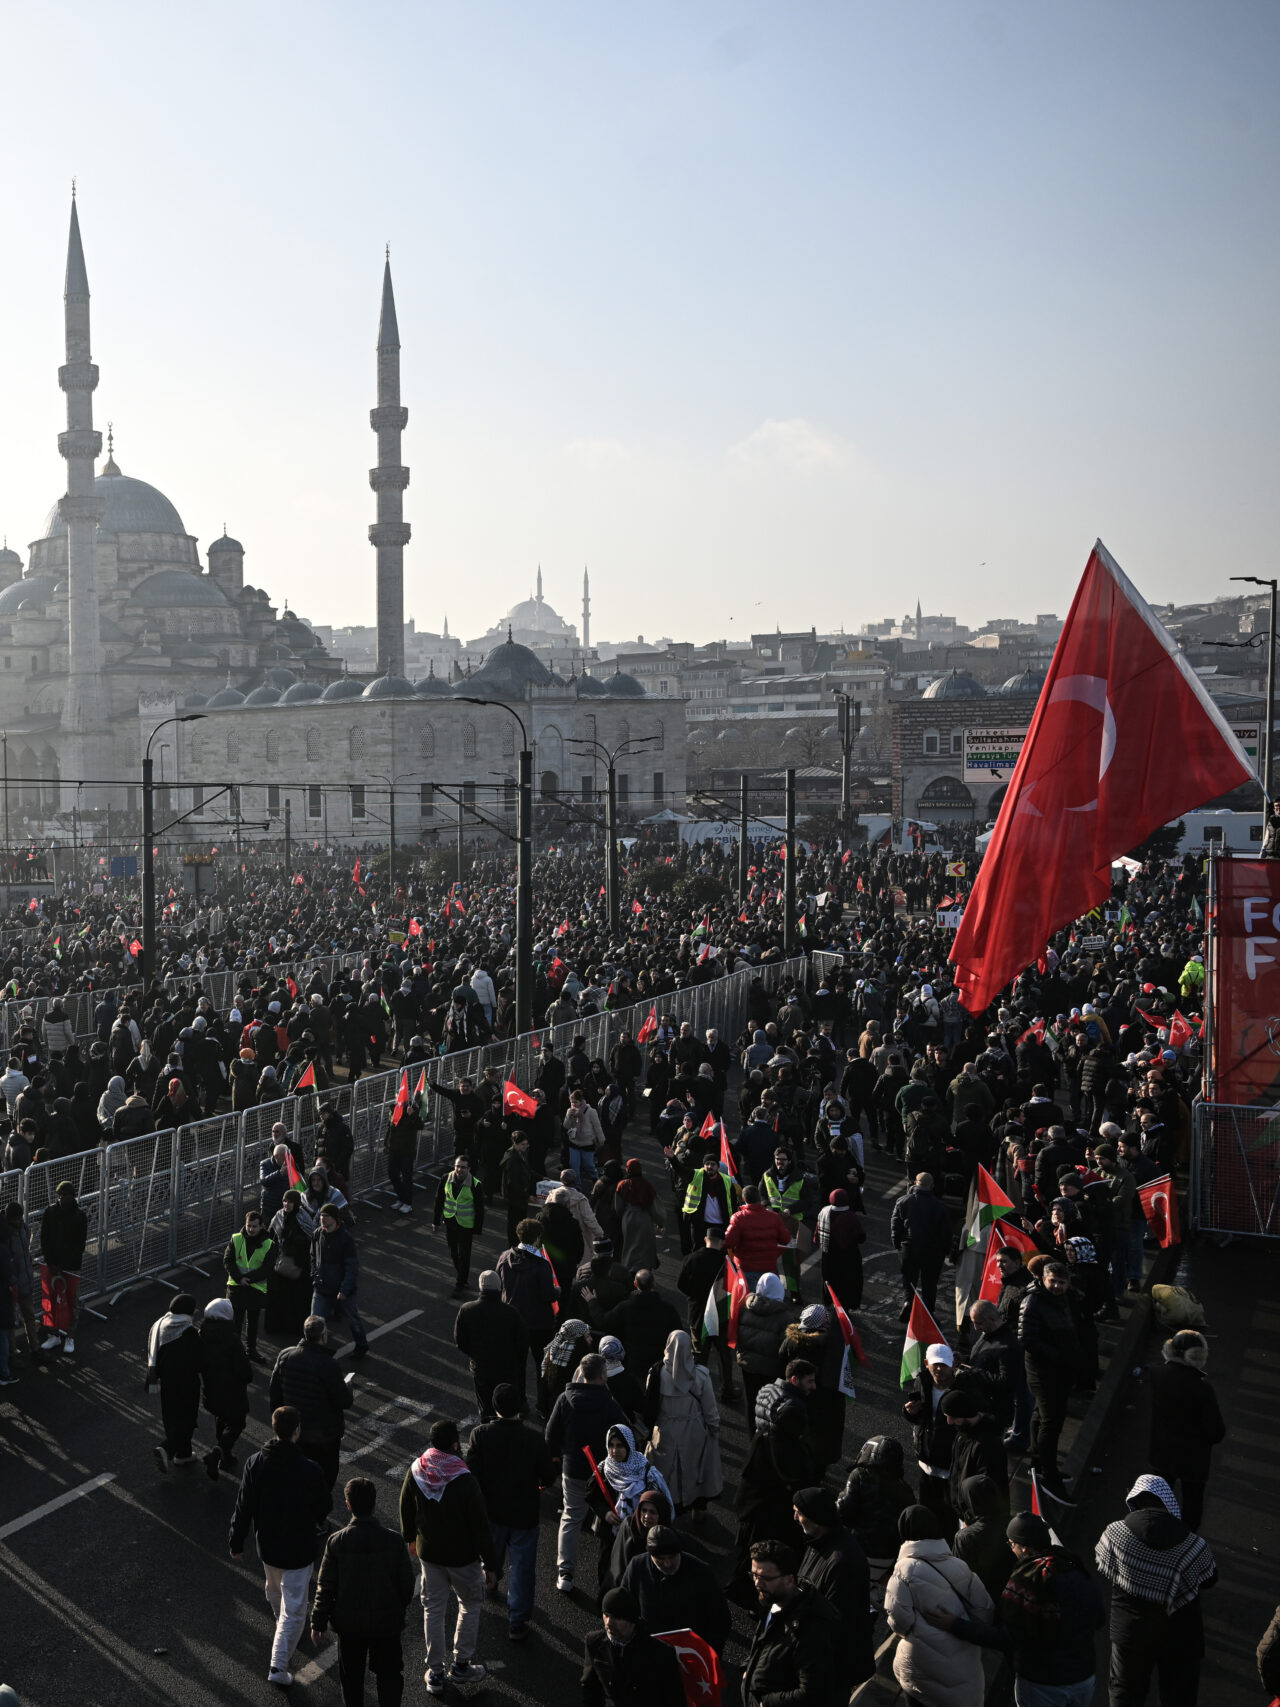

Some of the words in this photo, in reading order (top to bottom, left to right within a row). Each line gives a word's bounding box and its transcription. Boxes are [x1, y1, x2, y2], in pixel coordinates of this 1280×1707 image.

[1233, 730, 1256, 738] niye
[967, 736, 1025, 744] Sultanahme
[967, 752, 1000, 760] Avrasya
